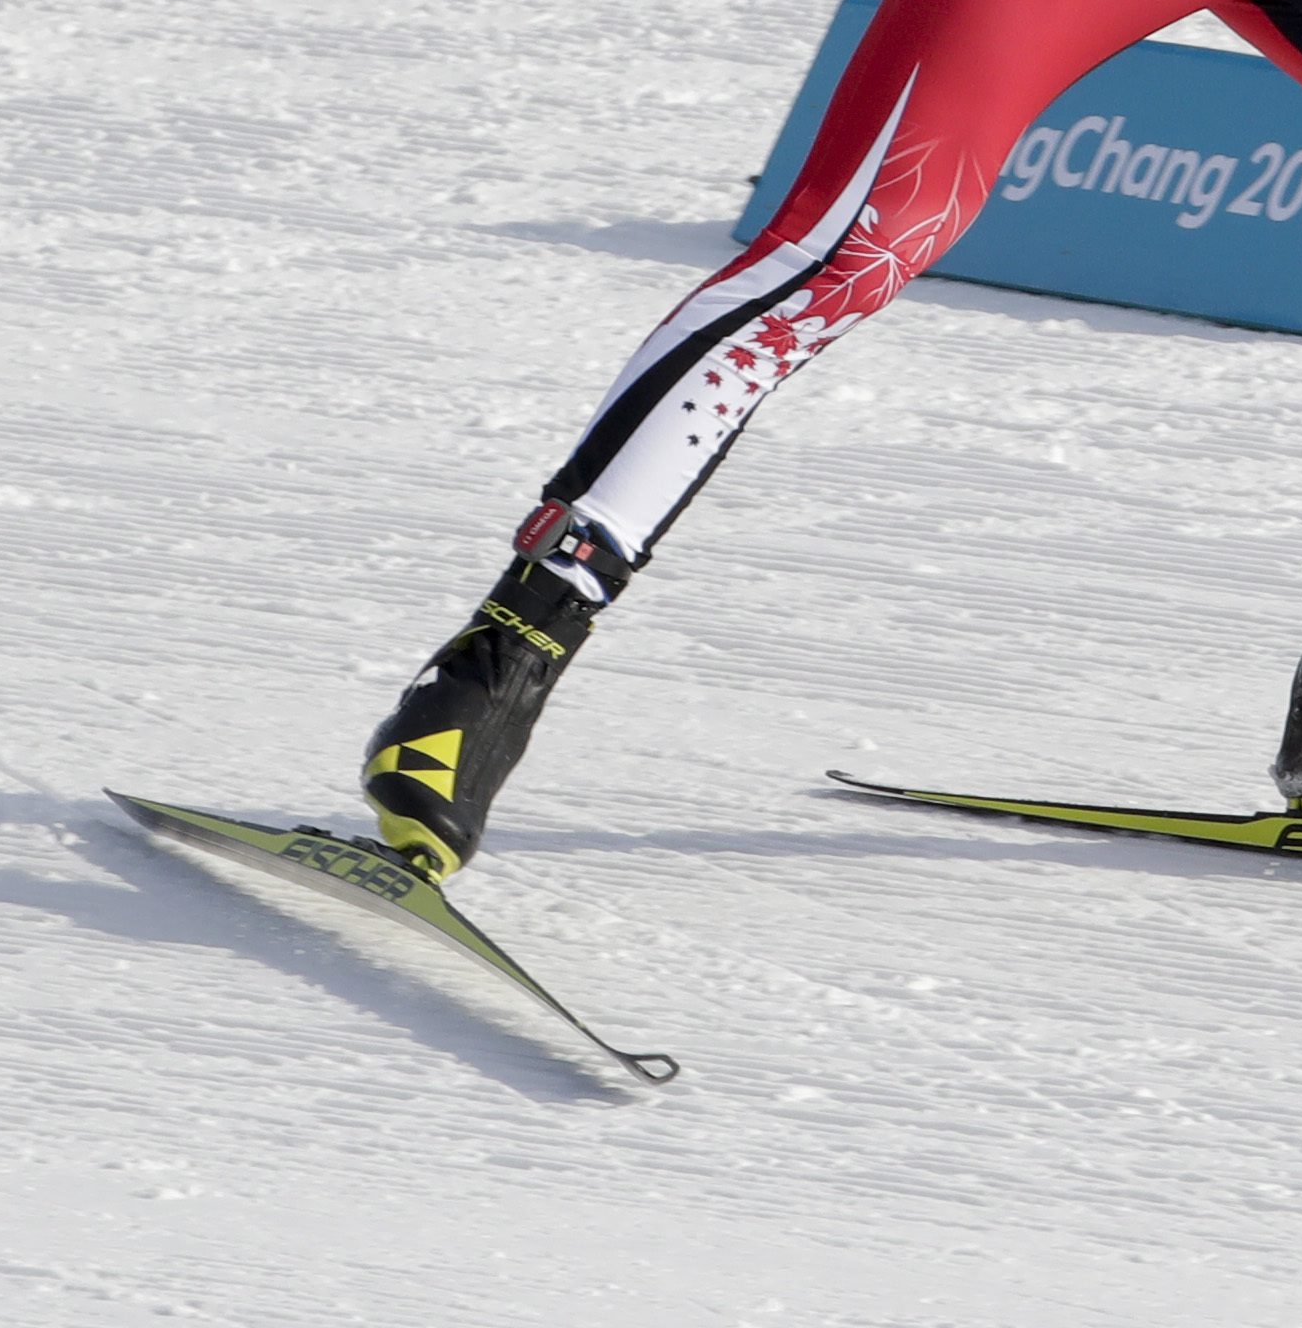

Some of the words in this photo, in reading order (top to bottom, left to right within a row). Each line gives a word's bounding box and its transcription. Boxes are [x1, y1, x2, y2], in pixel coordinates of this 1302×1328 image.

[999, 115, 1239, 229] gChang
[481, 598, 567, 661] SCHER
[280, 837, 416, 903] FISCHER
